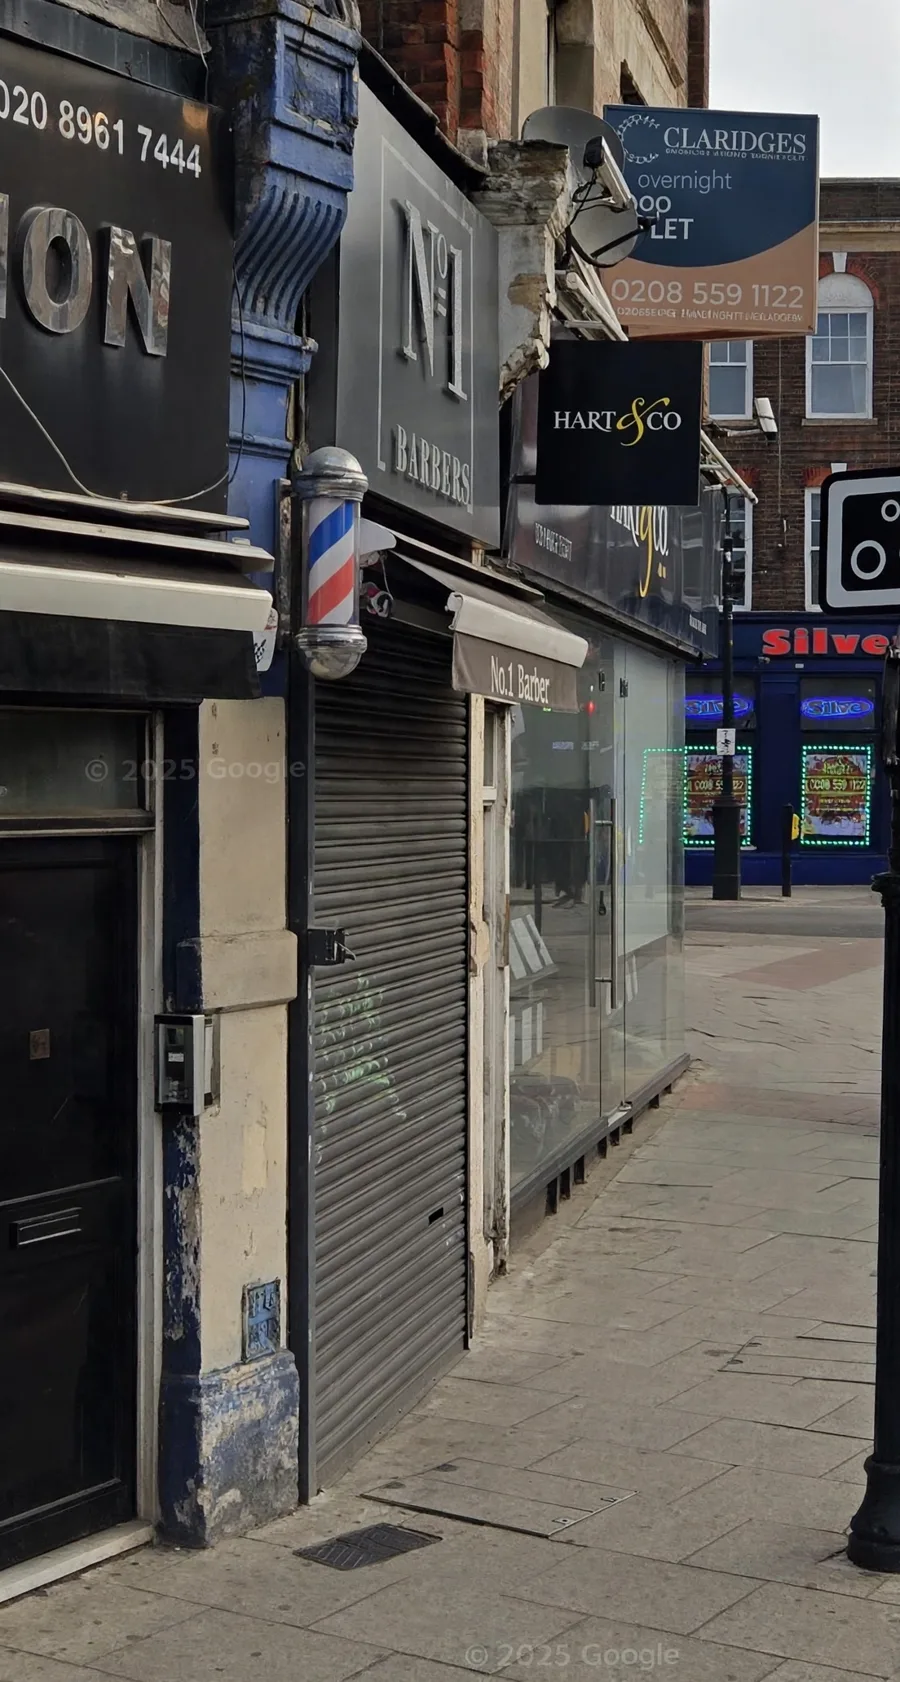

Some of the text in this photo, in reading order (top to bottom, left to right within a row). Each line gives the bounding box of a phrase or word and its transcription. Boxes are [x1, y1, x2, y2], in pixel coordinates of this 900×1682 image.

[0, 79, 201, 179] 020 8961 7444
[664, 127, 806, 155] CLARIDGES
[638, 169, 732, 194] overnight
[611, 278, 804, 309] 0208 559 1122
[396, 423, 470, 505] BARBERS
[491, 655, 550, 704] No.1 Barber
